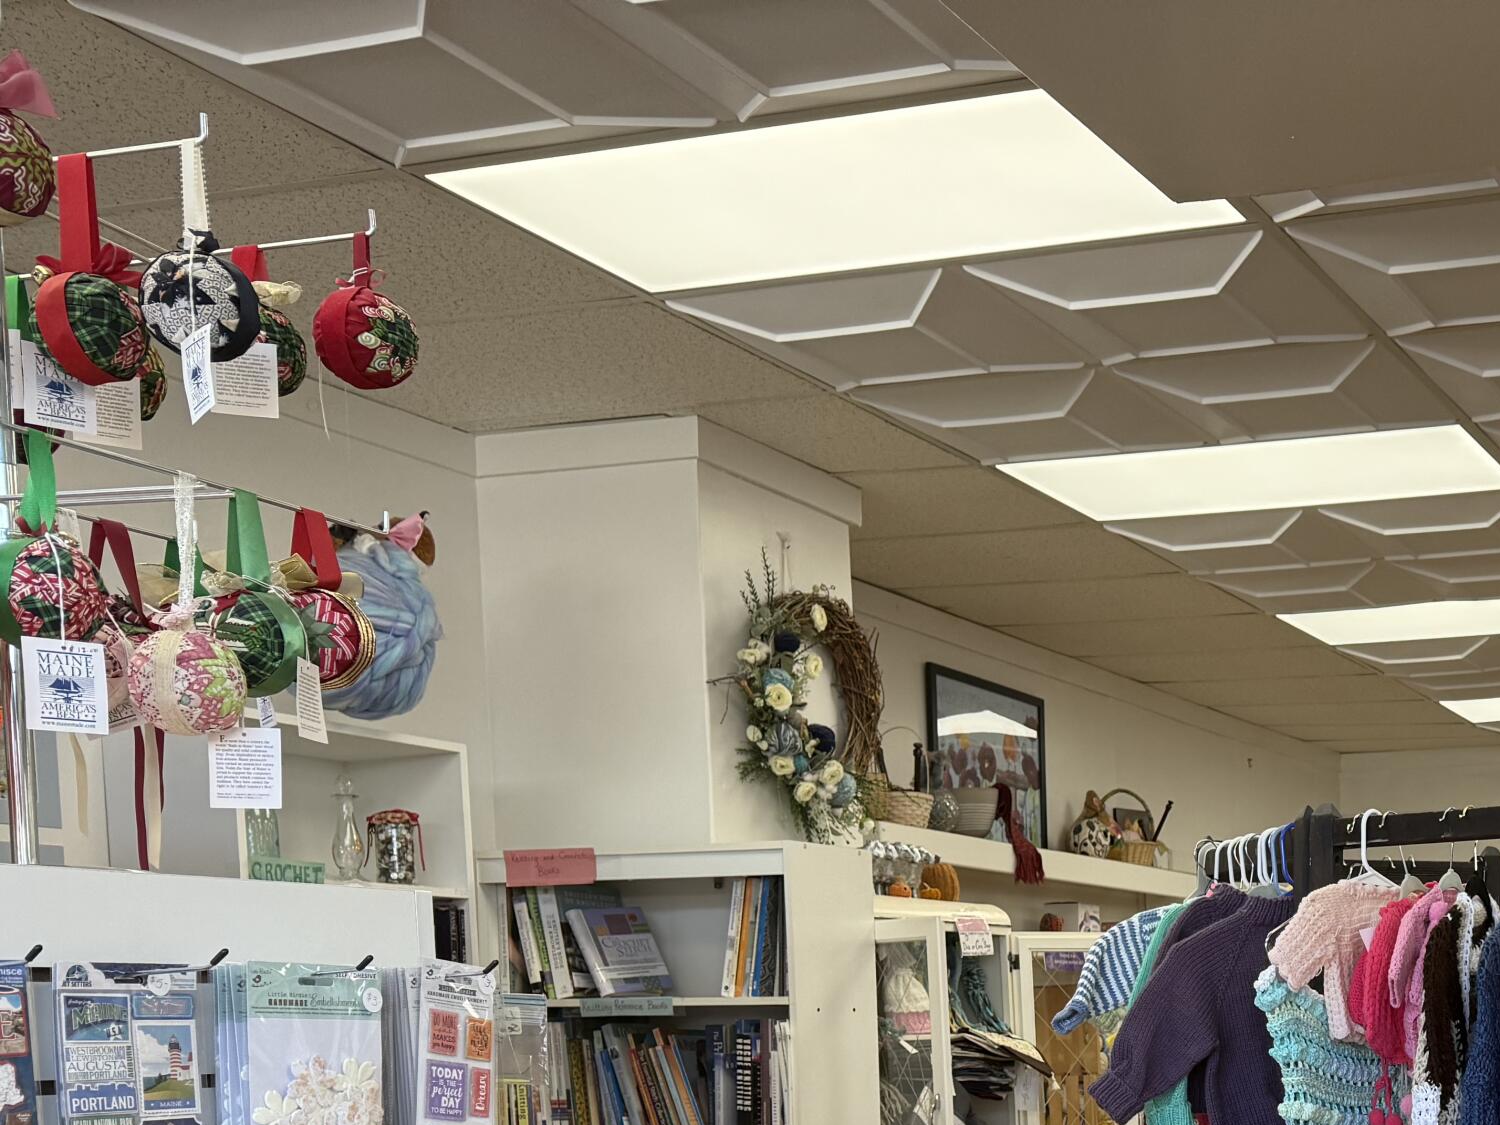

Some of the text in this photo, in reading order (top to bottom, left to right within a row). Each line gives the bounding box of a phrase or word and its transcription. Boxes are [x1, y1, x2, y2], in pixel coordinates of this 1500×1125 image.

[37, 652, 94, 668] MAINE
[38, 664, 95, 679] MADE
[41, 702, 97, 713] AMERICA'S
[250, 862, 323, 884] CROCHET
[67, 1060, 128, 1072] AUGUSTA
[431, 1066, 464, 1080] TODAY
[431, 1085, 463, 1098] perfect
[743, 1069, 751, 1111] KNITTING
[71, 1095, 135, 1112] PORTLAND
[441, 1096, 461, 1110] DAY
